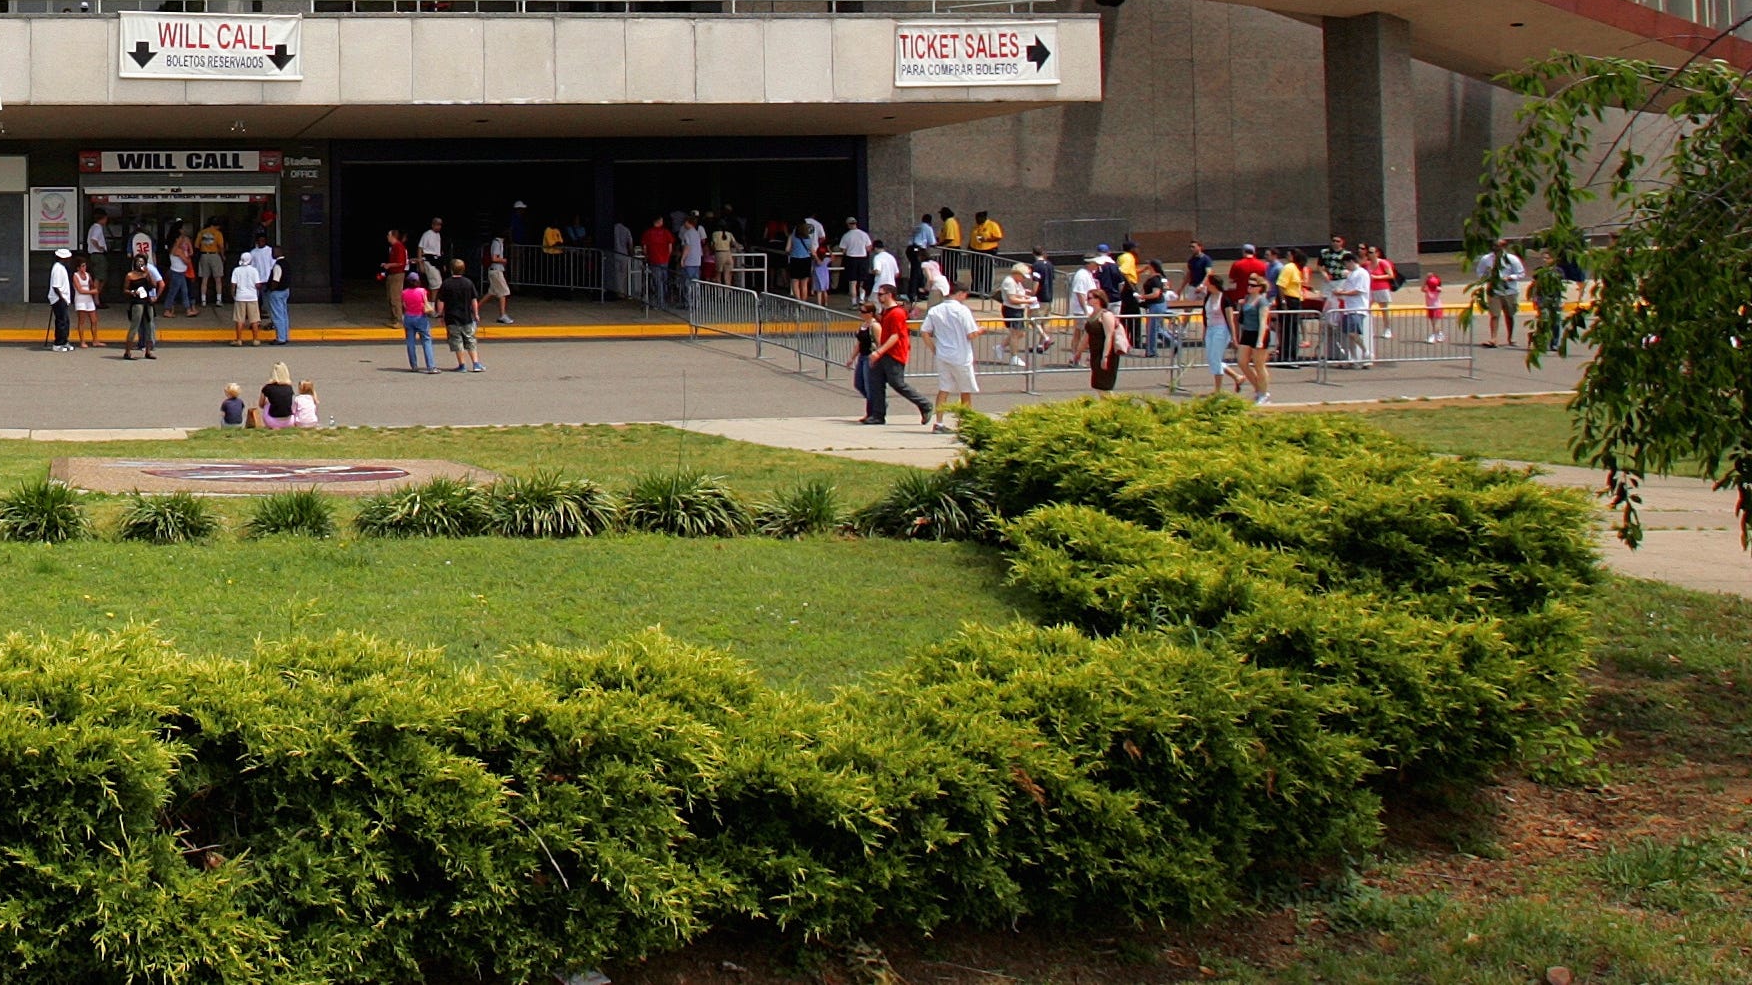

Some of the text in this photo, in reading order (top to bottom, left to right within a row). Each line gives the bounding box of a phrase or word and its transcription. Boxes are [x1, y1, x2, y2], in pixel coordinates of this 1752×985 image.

[158, 22, 274, 50] WILL CALL
[899, 32, 1020, 60] TICKET SALES
[166, 54, 264, 69] BOLETOS RESERVADOS
[901, 62, 1019, 76] PARA COMPRAR BOLETOS
[117, 153, 176, 170] WILL
[186, 153, 244, 170] CALL
[290, 169, 319, 179] OFFICE
[136, 242, 149, 253] 32
